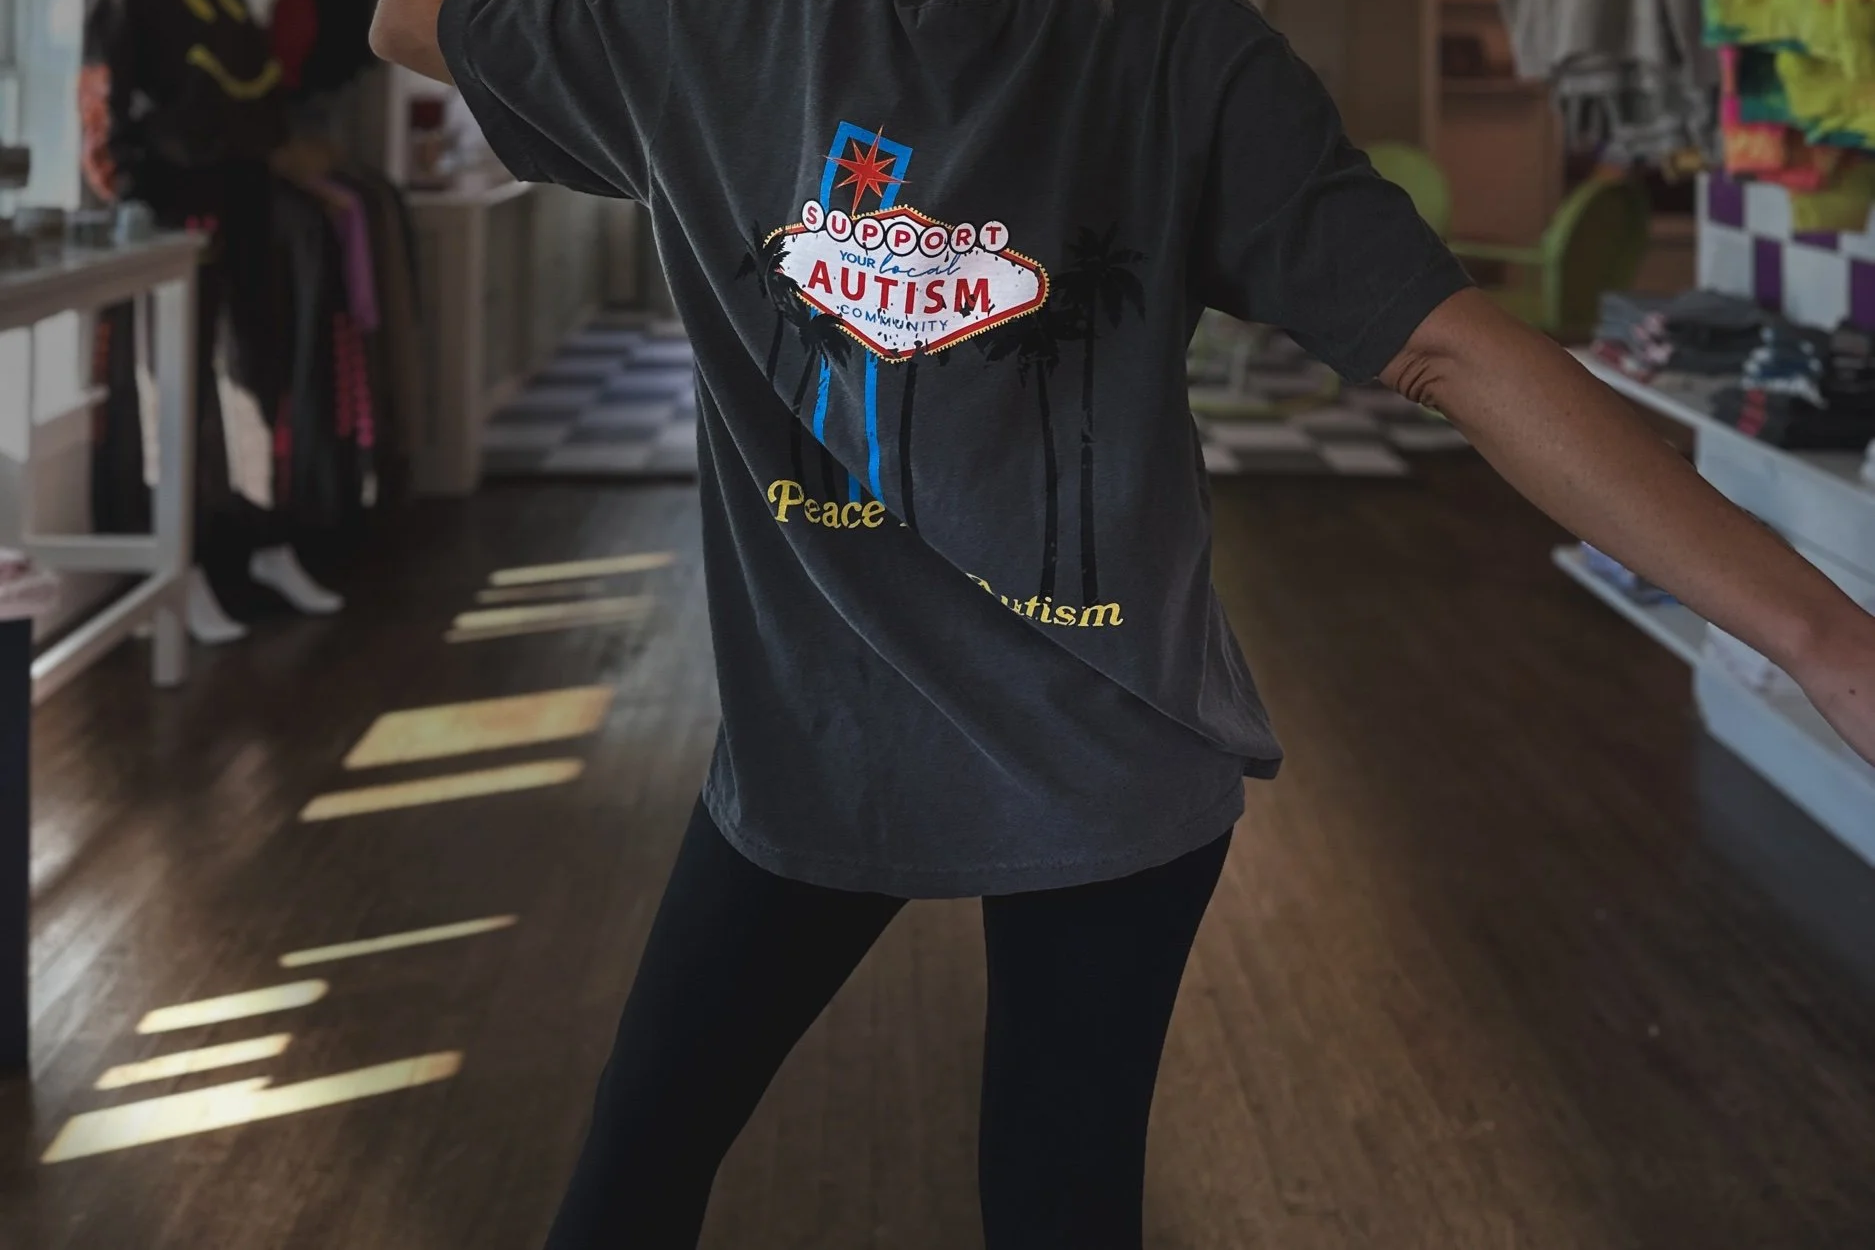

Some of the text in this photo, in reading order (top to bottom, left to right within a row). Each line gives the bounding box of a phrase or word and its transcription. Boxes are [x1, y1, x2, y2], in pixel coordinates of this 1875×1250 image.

[805, 205, 1002, 250] SUPPORT
[839, 249, 962, 278] YOUR local
[807, 259, 990, 315] AUTISM
[839, 303, 950, 332] COMMUNITY
[767, 479, 886, 529] Peace
